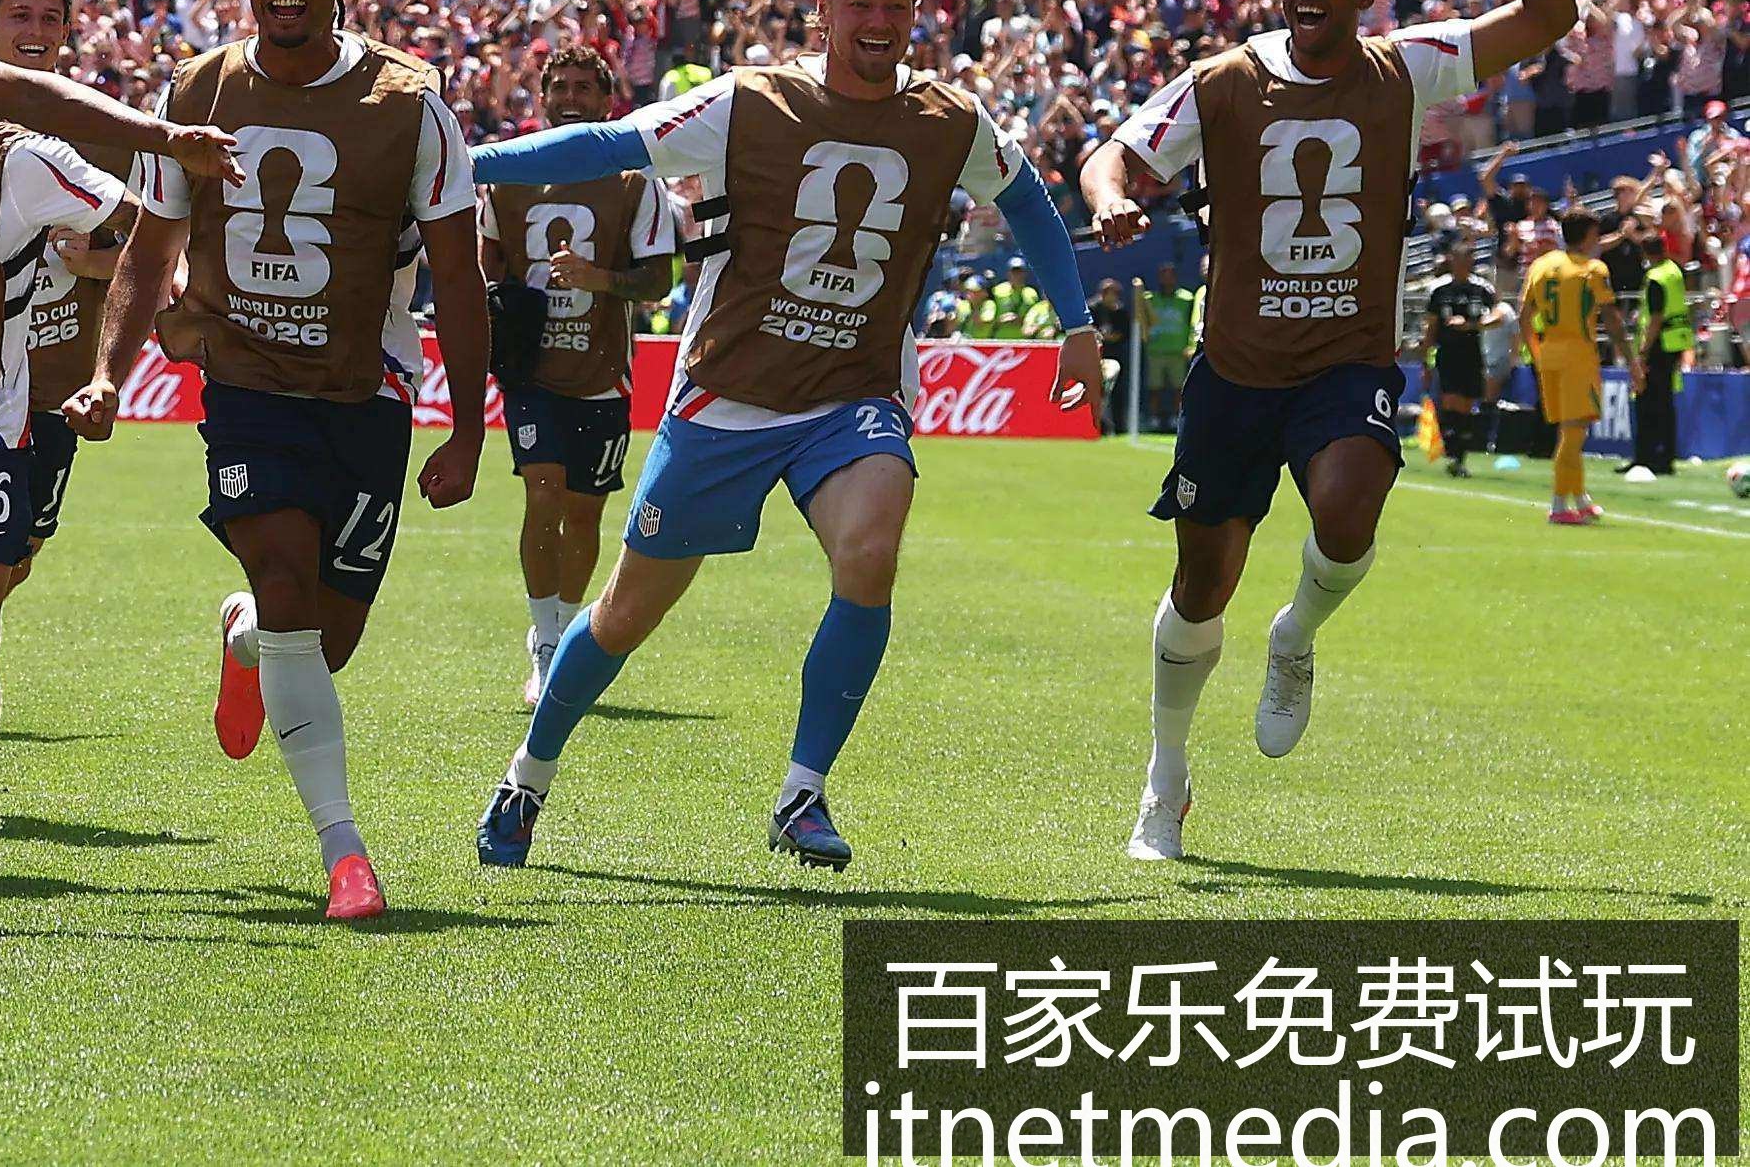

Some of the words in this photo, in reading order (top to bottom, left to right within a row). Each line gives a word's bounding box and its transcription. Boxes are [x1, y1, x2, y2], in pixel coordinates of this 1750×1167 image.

[1290, 244, 1336, 261] FIFA
[251, 261, 299, 283] FIFA
[809, 269, 855, 293] FIFA
[1261, 278, 1323, 293] WORLD
[1326, 278, 1359, 293] CUP
[50, 302, 78, 321] CUP
[228, 294, 286, 317] WORLD
[290, 305, 329, 320] CUP
[770, 297, 833, 322] WORLD
[834, 312, 868, 328] CUP
[1259, 294, 1359, 319] 2026
[566, 321, 591, 332] CUP
[759, 314, 858, 349] 2026
[540, 332, 589, 351] 026
[1374, 389, 1392, 419] 6
[597, 434, 626, 475] 10
[220, 466, 246, 480] USA
[335, 492, 394, 561] 12
